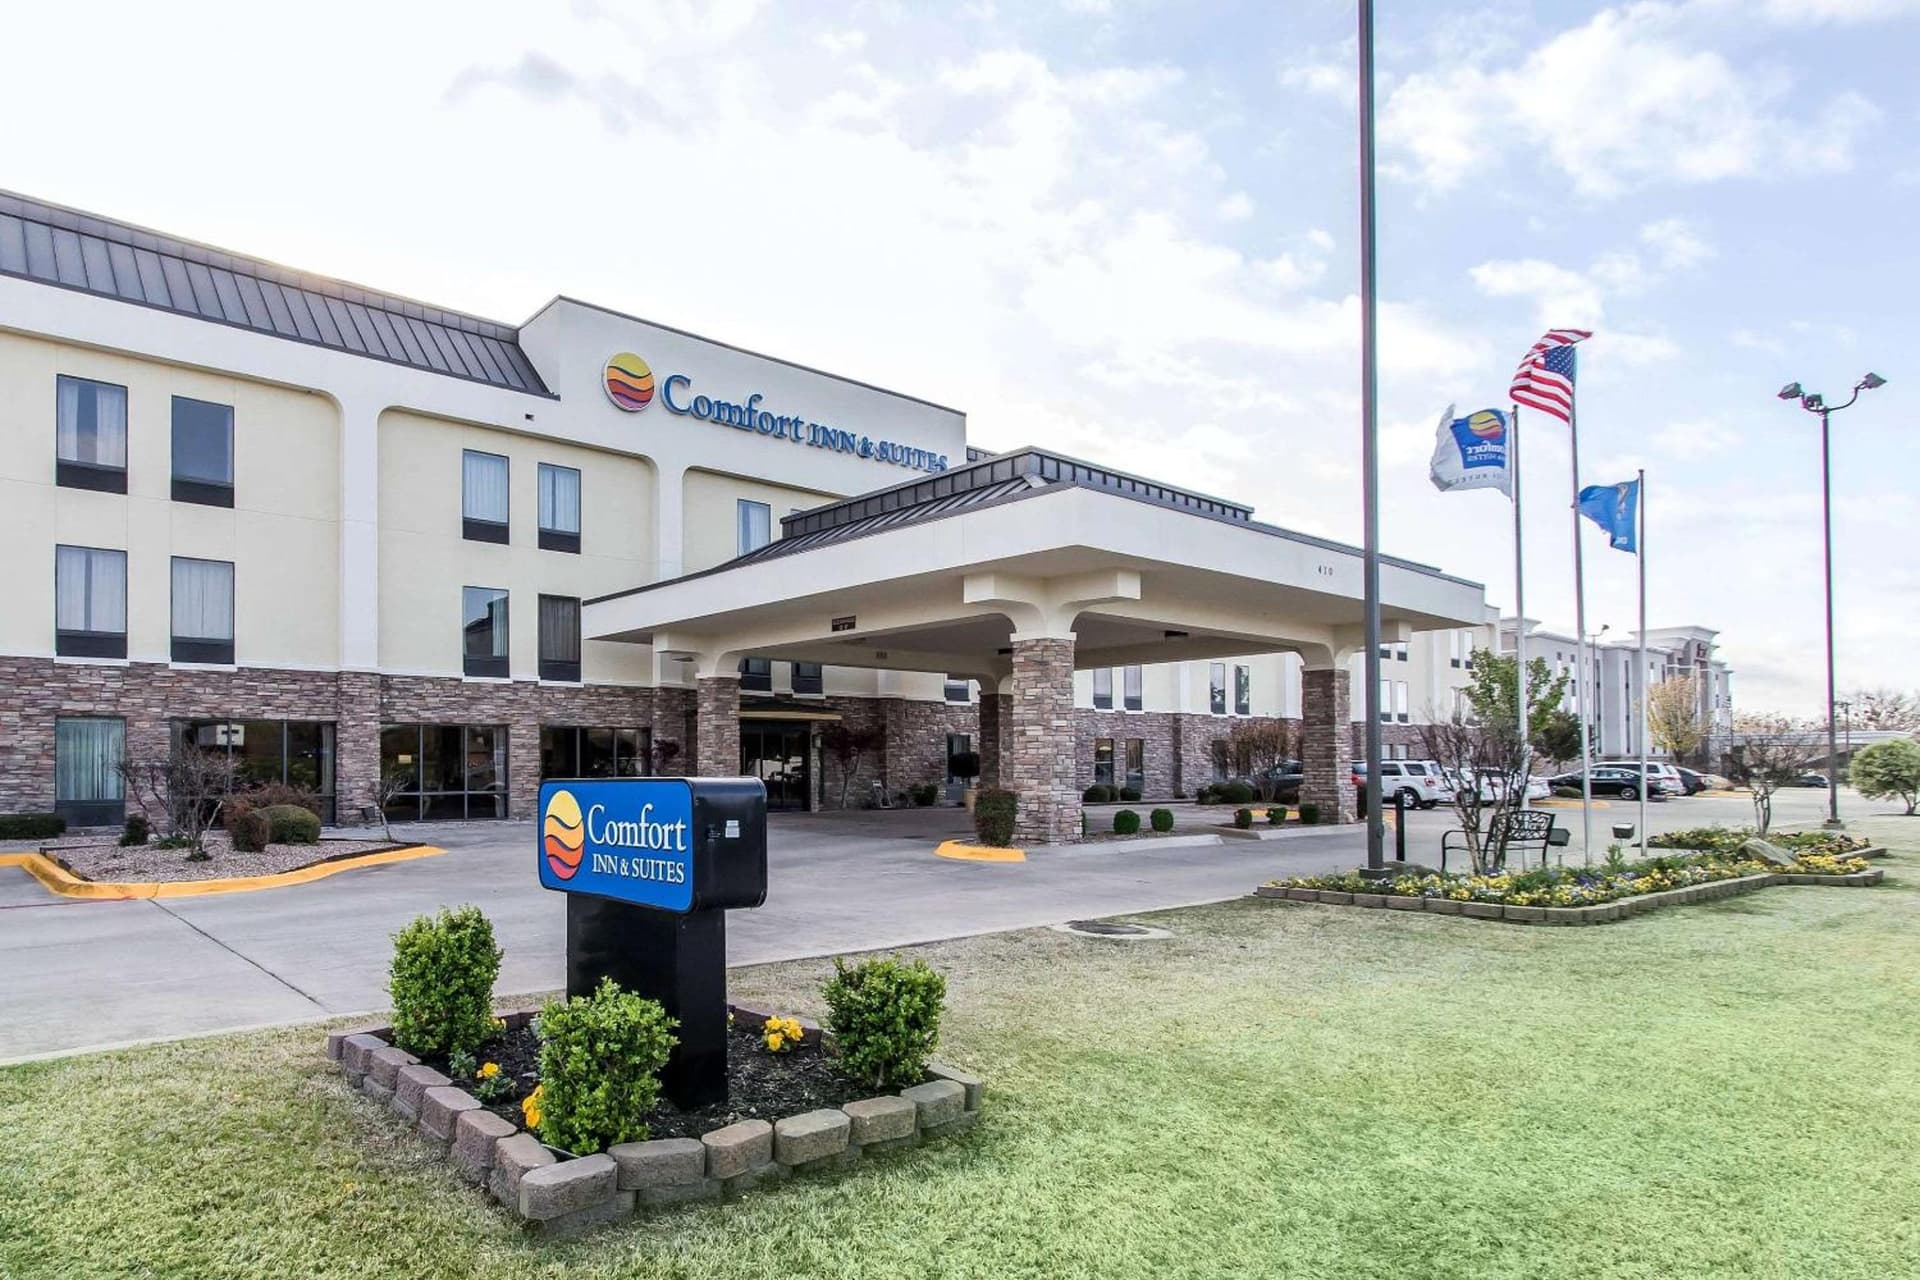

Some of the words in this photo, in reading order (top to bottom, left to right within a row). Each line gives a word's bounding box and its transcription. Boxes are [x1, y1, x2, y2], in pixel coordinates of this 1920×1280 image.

[661, 374, 805, 442] Comfort
[806, 422, 857, 453] INN
[857, 436, 874, 458] &
[875, 440, 949, 473] SUITES
[587, 803, 688, 852] Comfort
[592, 853, 619, 875] INN
[620, 858, 630, 877] &
[631, 857, 686, 884] SUITES
